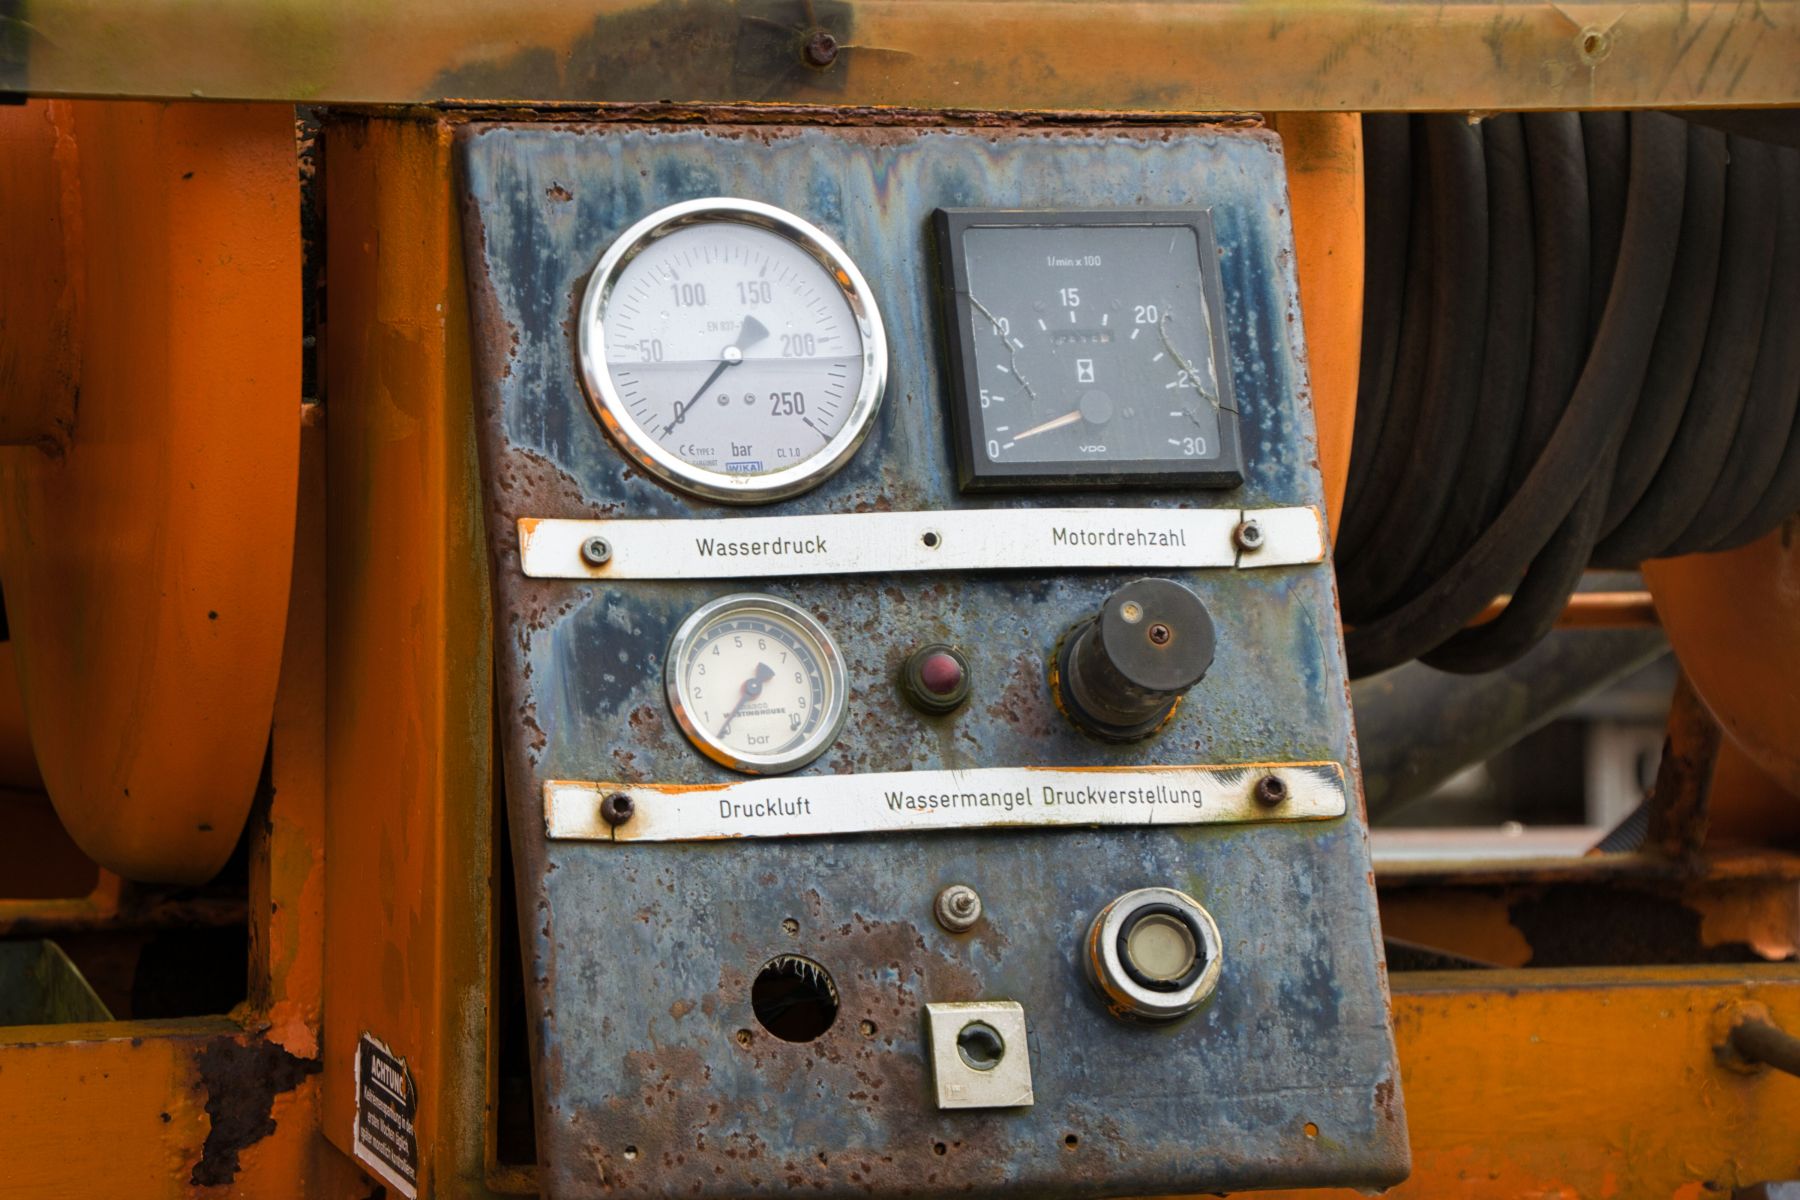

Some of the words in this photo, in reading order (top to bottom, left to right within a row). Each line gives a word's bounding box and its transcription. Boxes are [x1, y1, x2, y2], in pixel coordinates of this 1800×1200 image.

[1084, 255, 1102, 267] 100
[671, 283, 707, 307] 100
[737, 281, 772, 305] 150
[1060, 287, 1080, 307] 15
[1134, 305, 1158, 324] 20
[990, 316, 1010, 336] 10
[640, 338, 664, 362] 50
[780, 333, 816, 358] 200
[769, 391, 806, 417] 250
[980, 389, 990, 408] 5
[673, 401, 686, 424] 0
[731, 441, 753, 457] bar
[988, 439, 1000, 458] 0
[1079, 444, 1107, 453] VDO
[1182, 437, 1207, 456] 30
[728, 463, 757, 473] WIKA
[695, 535, 827, 557] Wasserdruck
[1052, 527, 1187, 547] Motordrehzahl
[712, 645, 720, 656] 4
[734, 636, 743, 648] 5
[758, 639, 767, 651] 6
[779, 652, 788, 664] 7
[698, 663, 706, 676] 3
[794, 671, 803, 684] 8
[694, 687, 703, 699] 2
[798, 696, 806, 709] 9
[704, 711, 710, 723] 1
[788, 713, 801, 726] 10
[747, 733, 770, 745] bar
[884, 787, 1033, 811] Wassermangel
[1042, 786, 1203, 809] Druckverstellung
[719, 796, 811, 819] Druckluft
